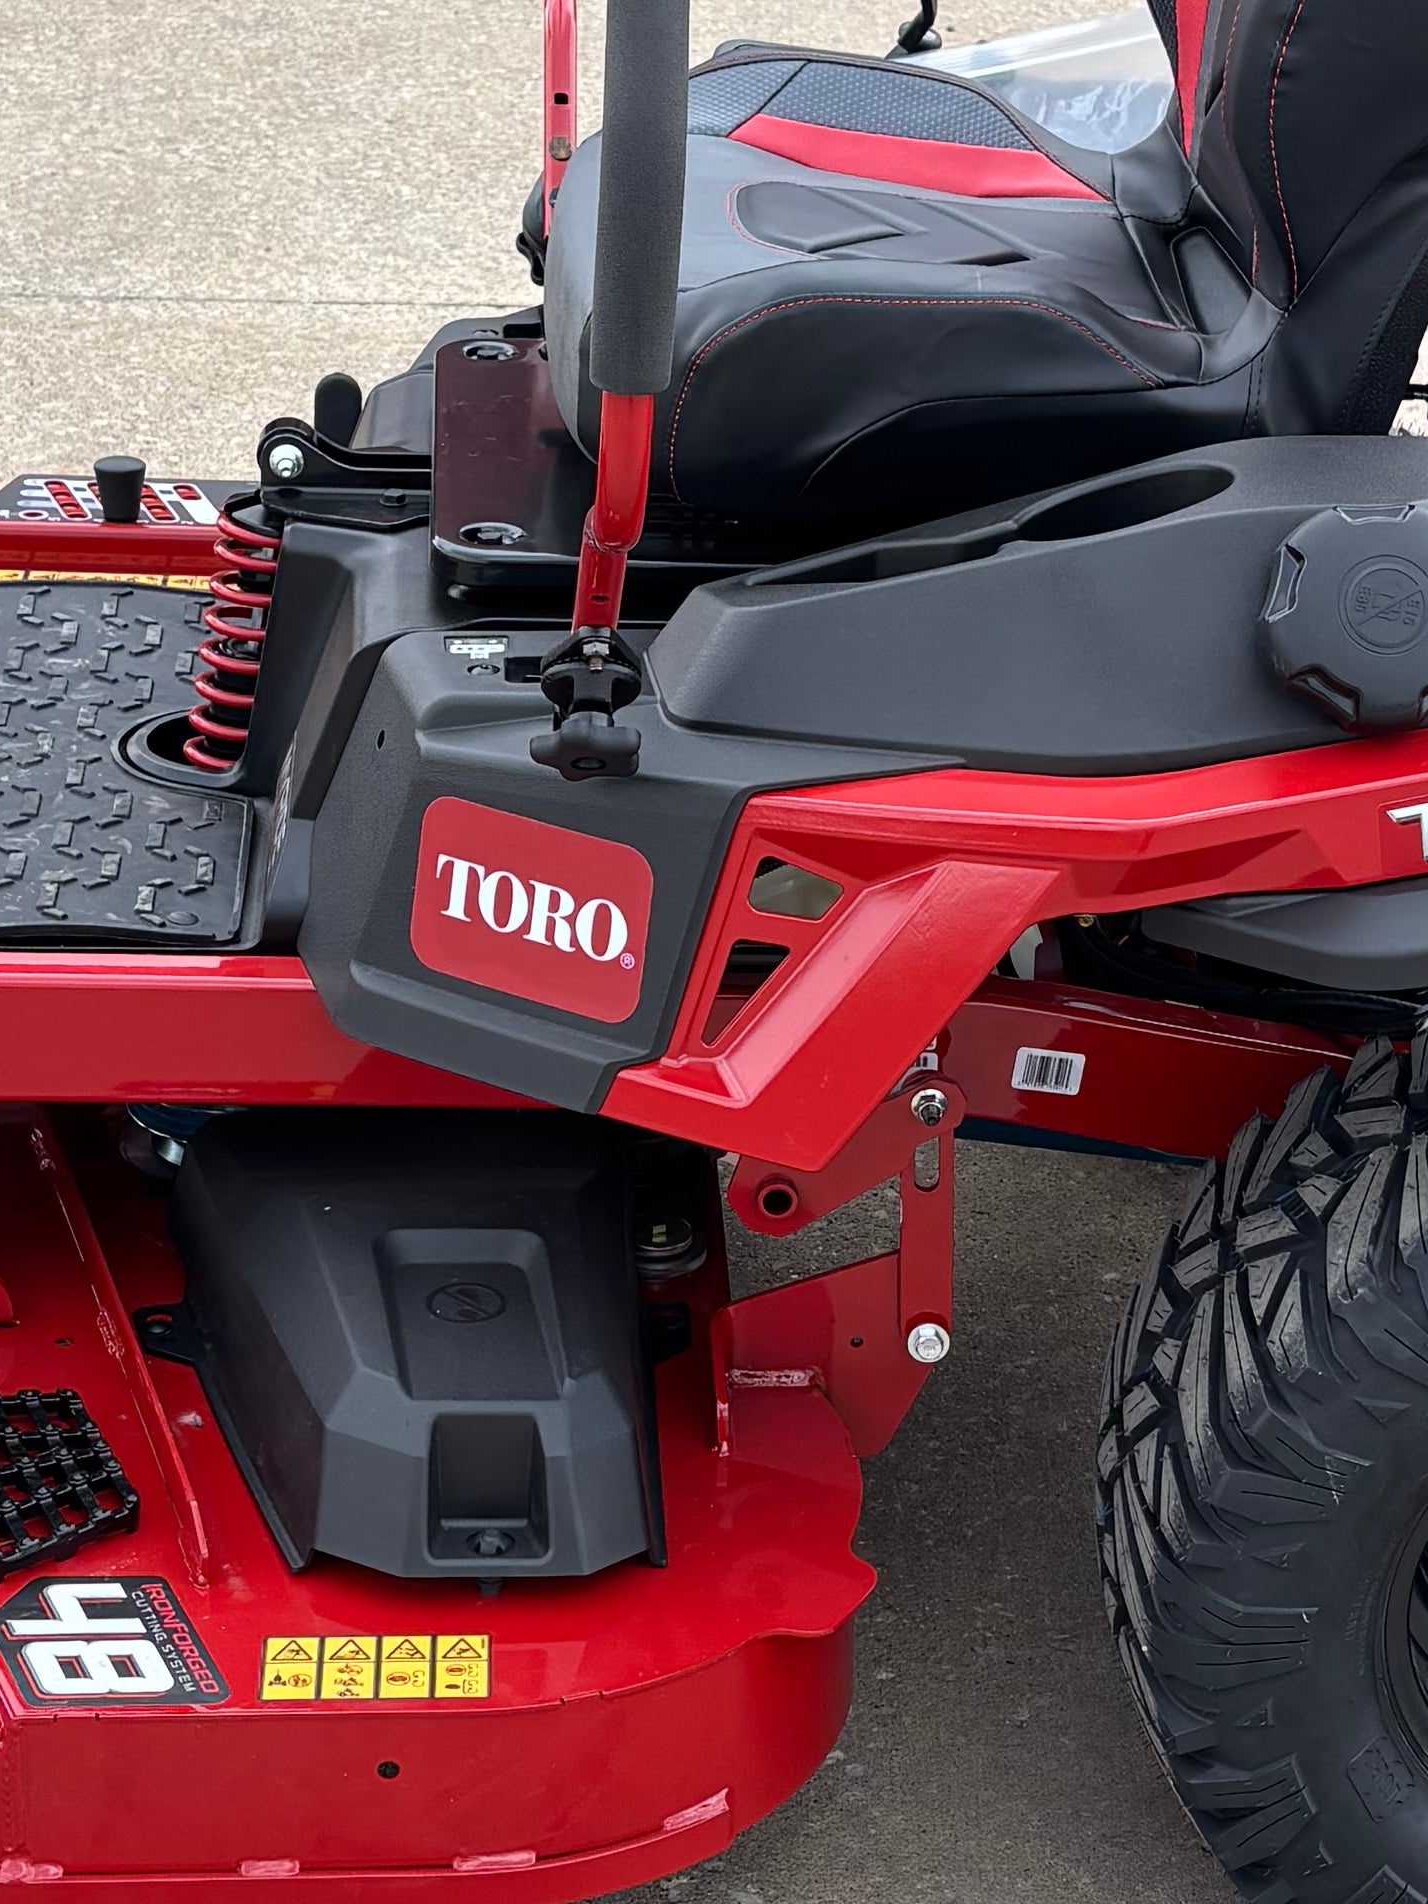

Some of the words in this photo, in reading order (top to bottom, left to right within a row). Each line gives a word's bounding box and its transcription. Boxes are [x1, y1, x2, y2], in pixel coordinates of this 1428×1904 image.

[436, 853, 628, 962] TORO
[1, 1582, 175, 1700] 48
[131, 1590, 167, 1643] CUTTING
[161, 1644, 197, 1693] SYSTEM
[139, 1582, 221, 1694] IRONFORGED
